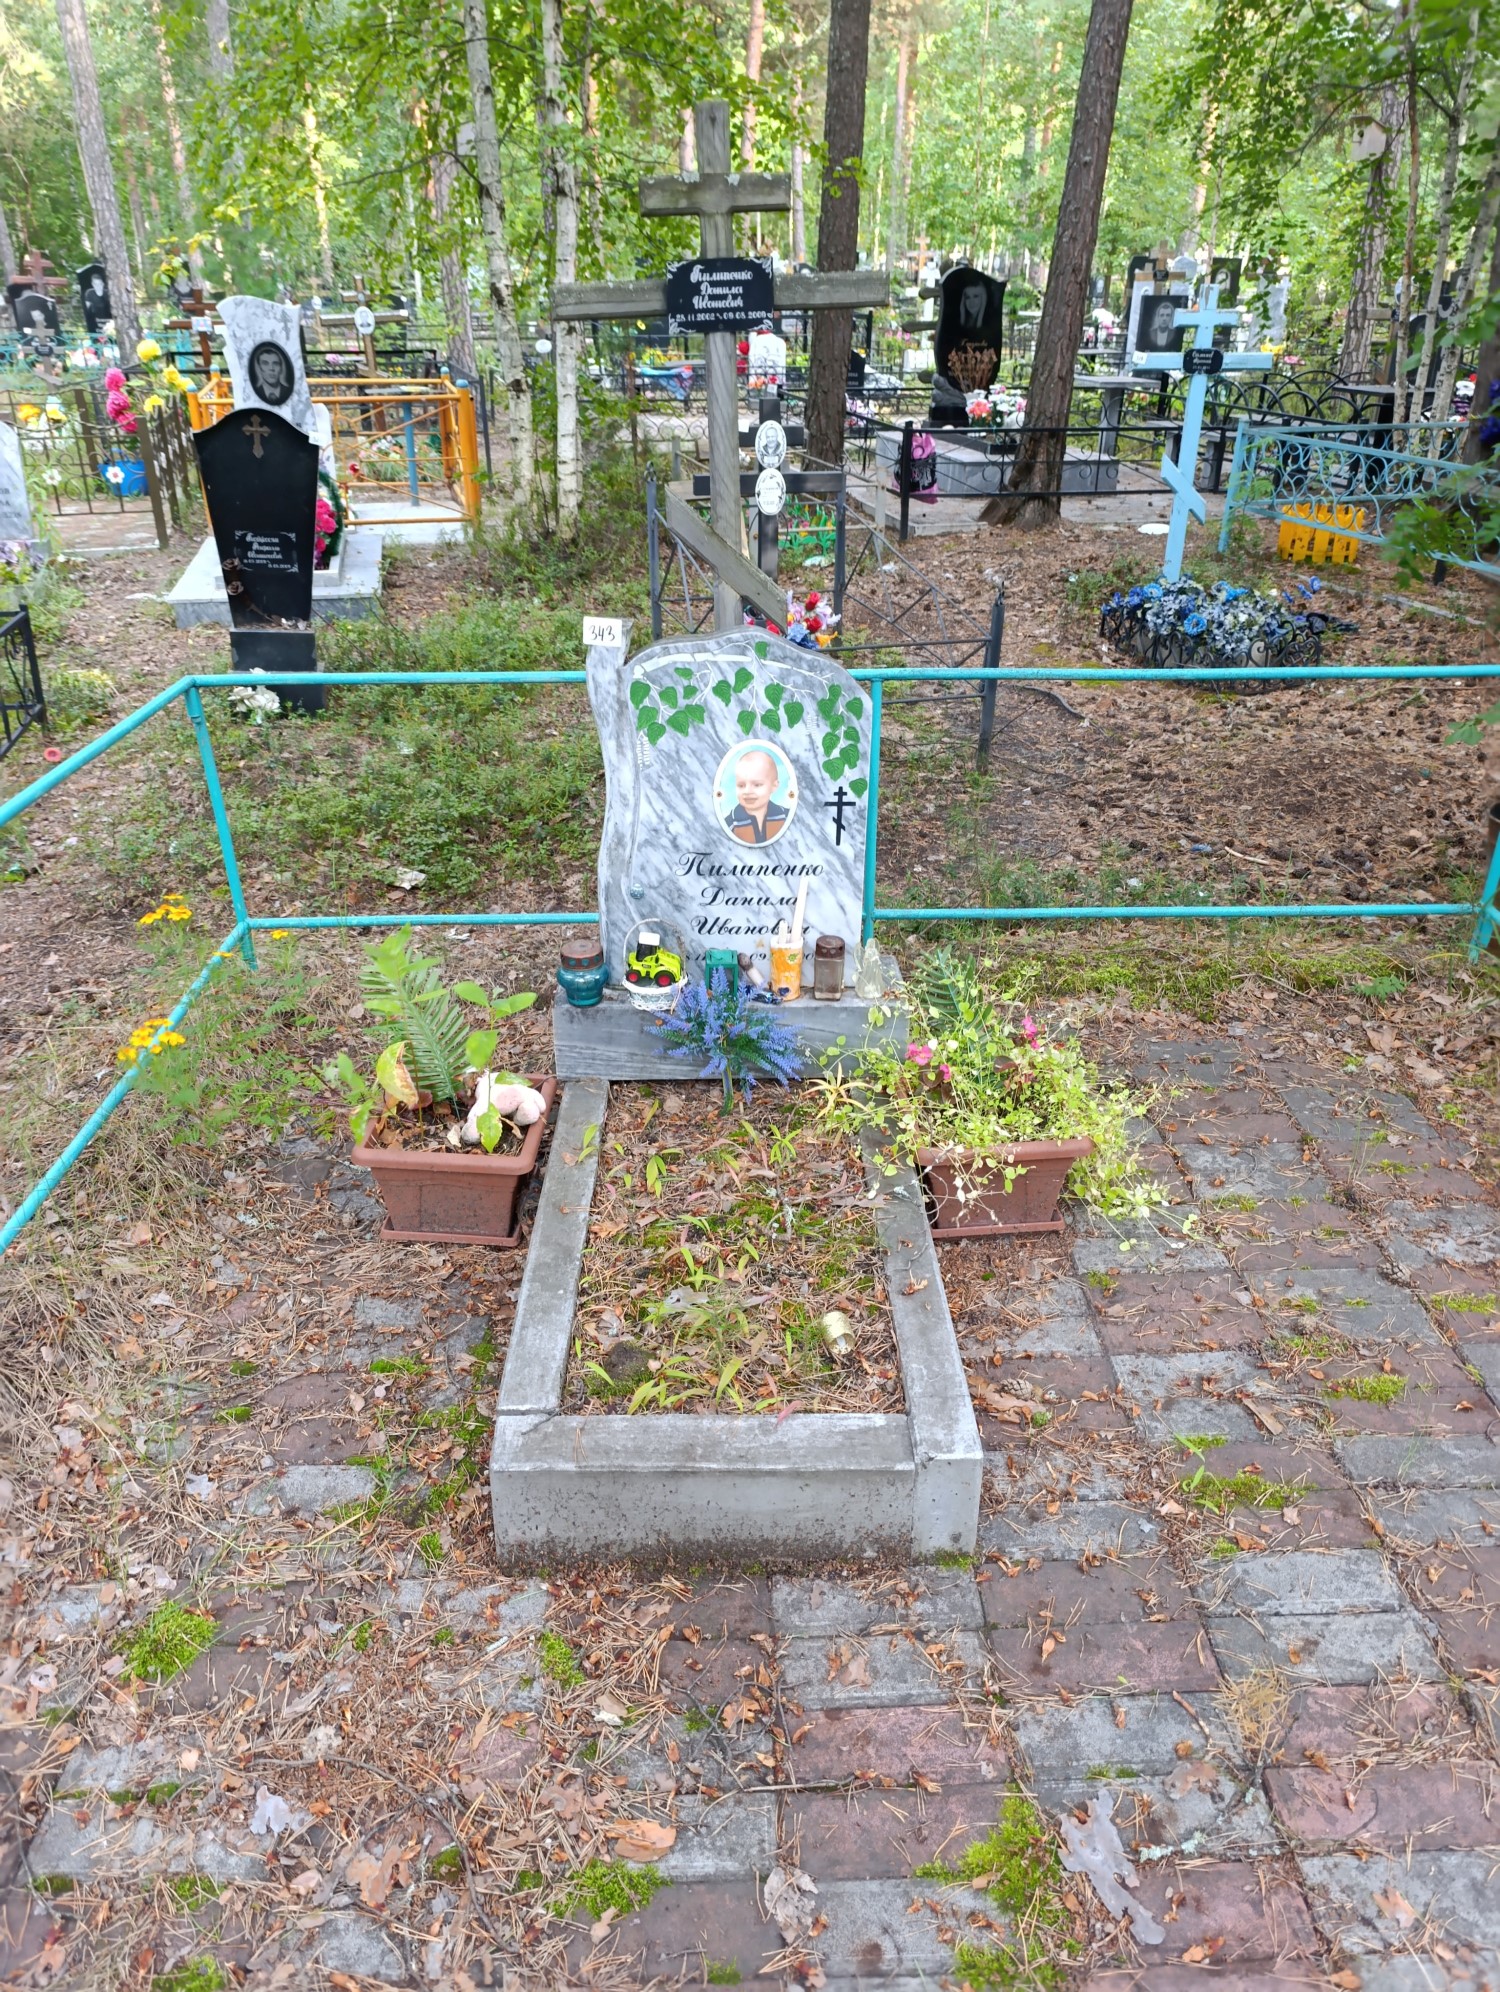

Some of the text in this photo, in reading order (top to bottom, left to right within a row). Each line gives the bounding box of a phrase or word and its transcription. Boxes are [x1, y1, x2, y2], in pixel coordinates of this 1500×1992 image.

[690, 264, 753, 283] Пилипенко
[700, 282, 743, 295] Данила
[692, 294, 744, 309] Иванович
[589, 624, 616, 642] 343
[675, 851, 824, 877] Пилипенко
[700, 886, 799, 906] Данила
[691, 915, 811, 936] Ивановч
